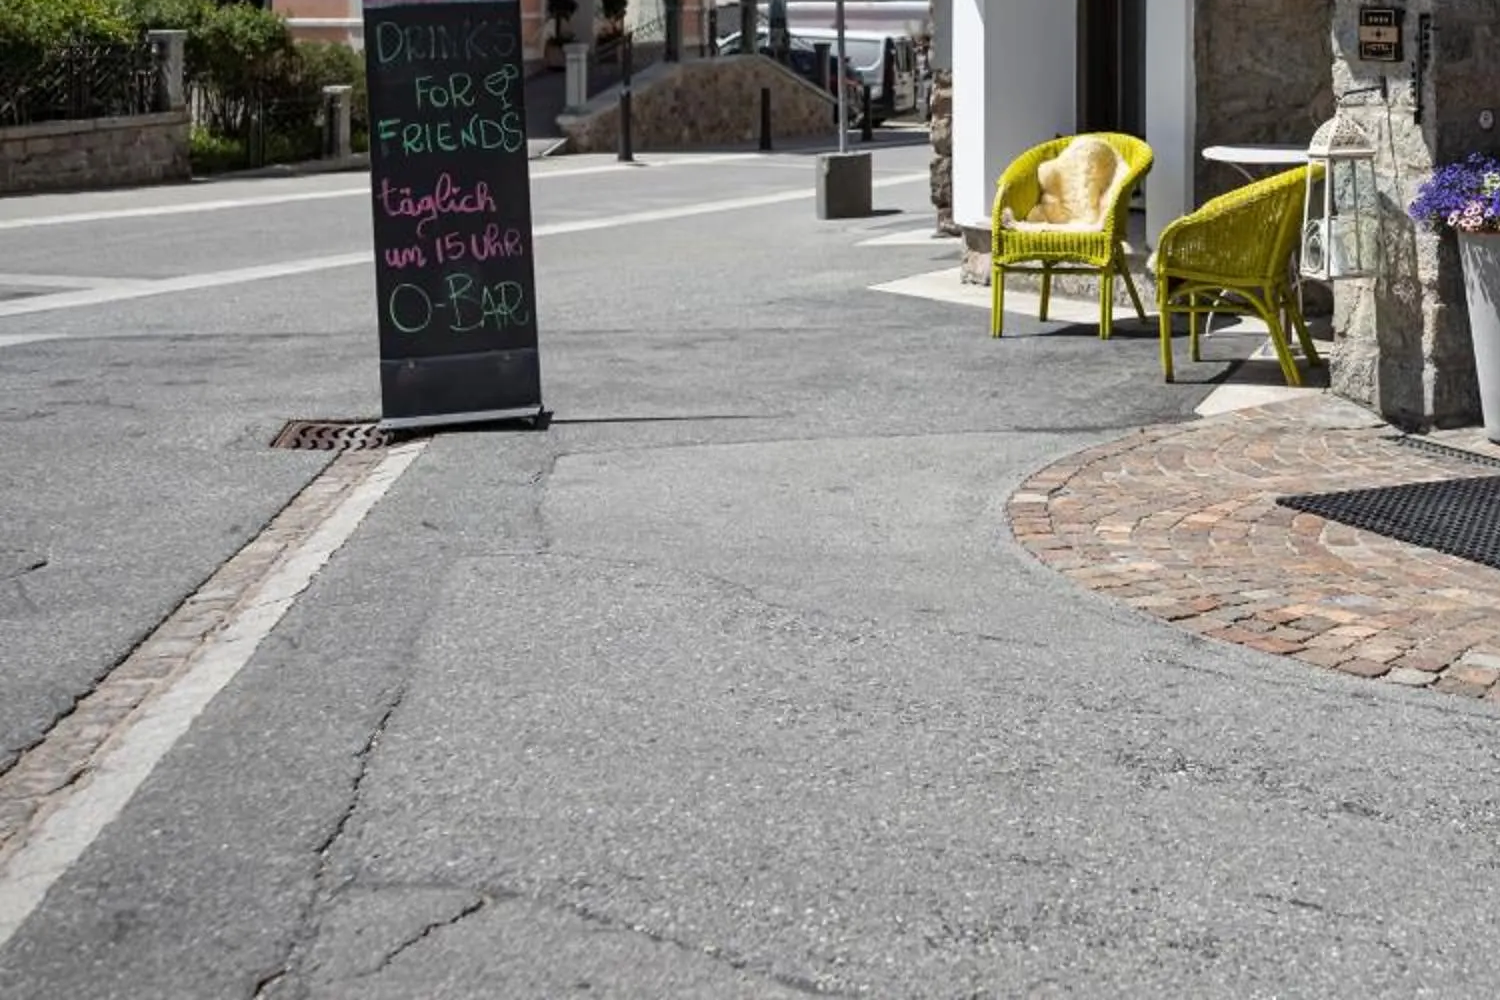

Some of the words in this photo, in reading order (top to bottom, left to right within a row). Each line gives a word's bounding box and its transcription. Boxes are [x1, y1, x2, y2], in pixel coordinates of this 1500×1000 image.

[376, 20, 517, 63] DRINKS
[378, 112, 523, 156] FRIENDS
[385, 244, 427, 269] um
[435, 231, 465, 264] 15
